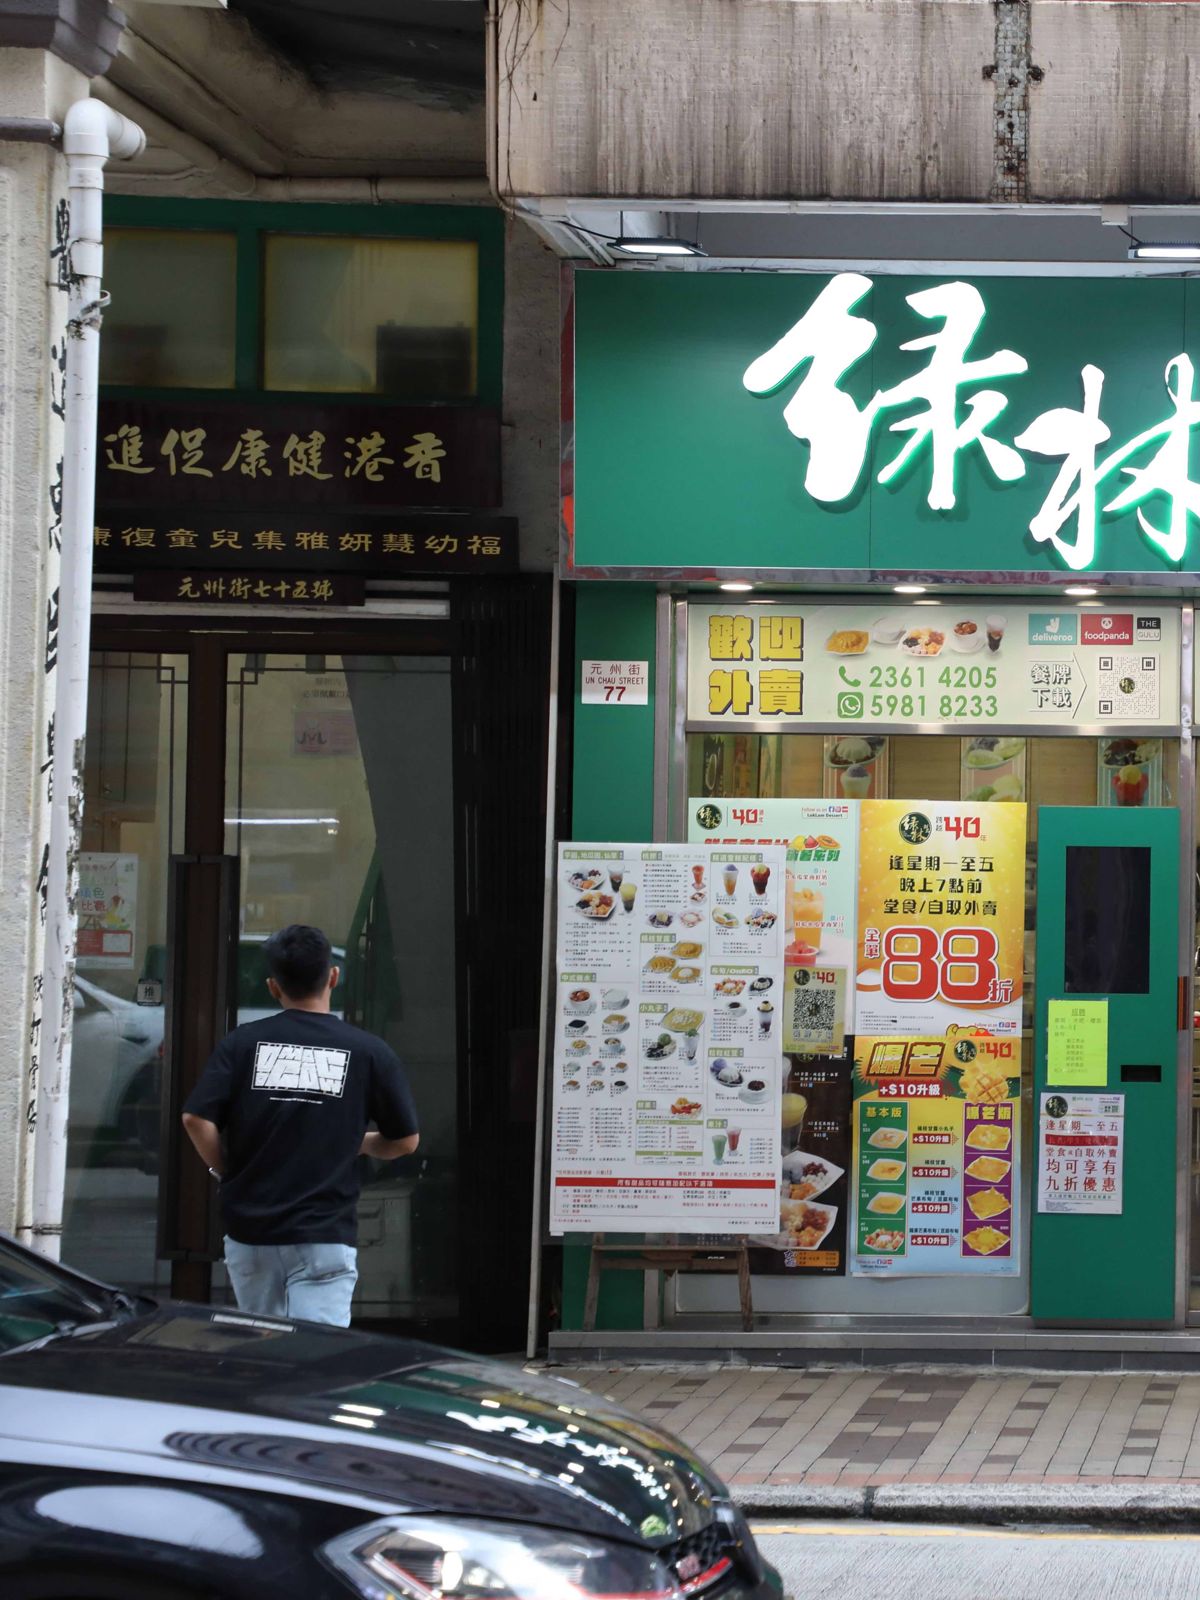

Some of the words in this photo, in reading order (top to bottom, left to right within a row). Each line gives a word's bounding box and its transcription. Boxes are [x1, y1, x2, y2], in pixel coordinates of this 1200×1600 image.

[1140, 619, 1158, 627] THE
[1032, 632, 1073, 642] deliveroo
[1084, 631, 1130, 643] foodpanda
[590, 663, 641, 676] 元州街
[869, 665, 927, 688] 2361
[938, 665, 998, 689] 4205
[1030, 663, 1072, 686] 餐牌
[585, 677, 596, 685] UN
[597, 677, 616, 685] CHAU
[618, 677, 645, 686] STREET
[603, 686, 627, 702] 77
[1030, 687, 1072, 709] 下載
[870, 695, 927, 718] 5981
[938, 695, 999, 718] 8233
[732, 808, 759, 826] 40
[944, 816, 981, 841] 40
[889, 855, 995, 873] 逢星期一至五
[900, 877, 983, 894] 晚上7點前
[884, 898, 998, 916] 堂食/自取外賣
[881, 925, 999, 1003] 88
[988, 978, 1014, 1003] 折
[985, 1042, 1012, 1060] 40
[879, 1083, 941, 1096] +$10升級
[866, 1107, 902, 1118] 基本版
[1046, 1159, 1117, 1175] 均可享有
[1046, 1176, 1116, 1192] 九折優惠
